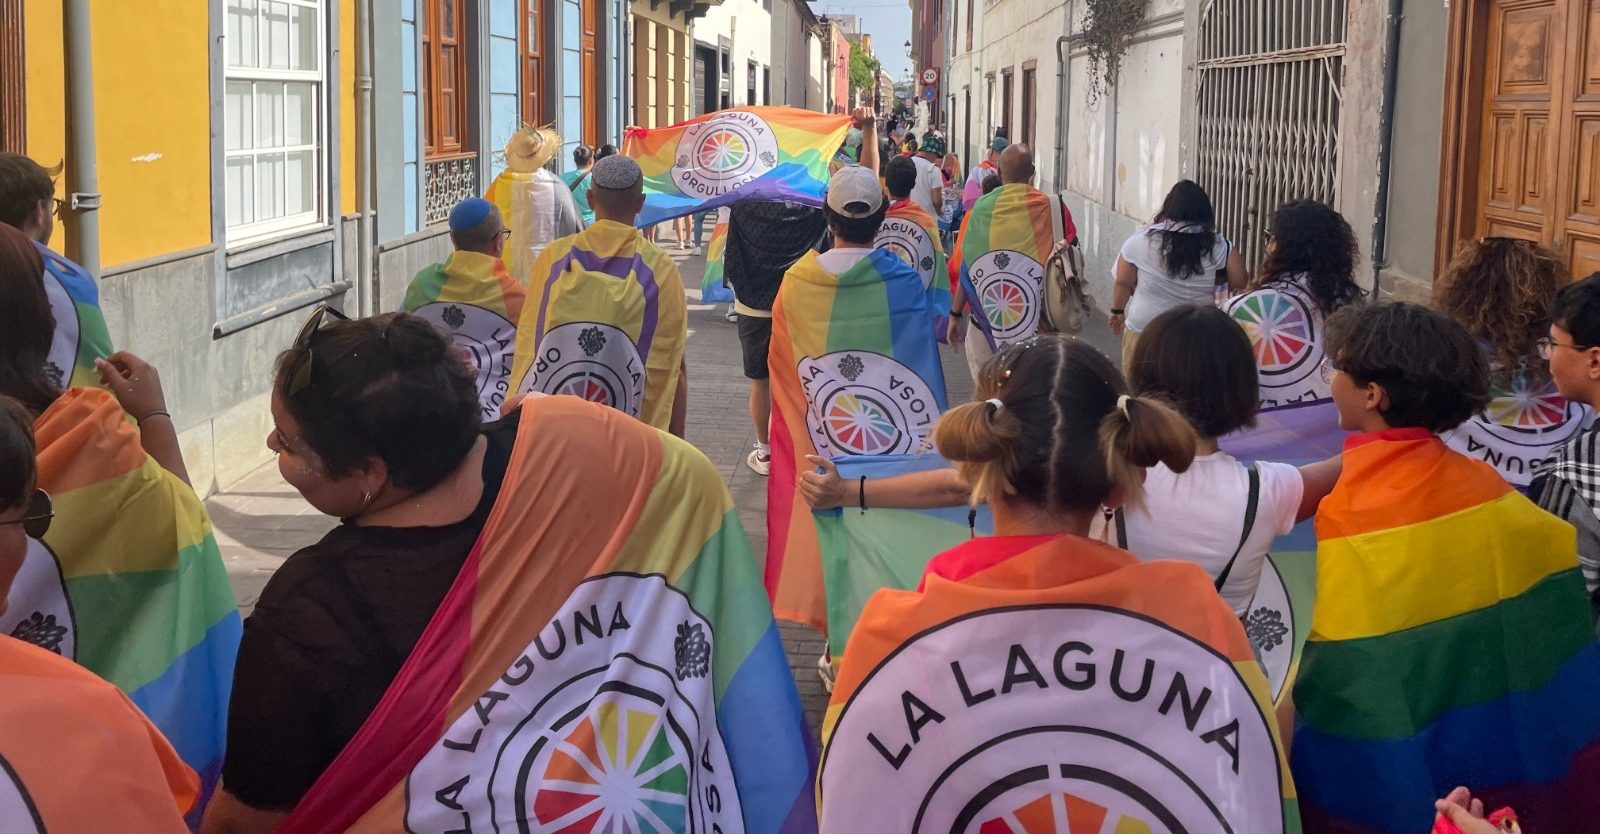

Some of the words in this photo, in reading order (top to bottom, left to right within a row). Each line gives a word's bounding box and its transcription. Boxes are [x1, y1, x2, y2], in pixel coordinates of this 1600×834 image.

[925, 72, 935, 80] 20
[879, 222, 923, 244] AGUNA
[1028, 267, 1043, 286] LA
[491, 328, 510, 351] LA
[482, 353, 515, 418] LAGUN
[1466, 434, 1543, 475] GUNA
[442, 601, 631, 753] LAGUNA
[866, 690, 946, 771] LA
[949, 640, 1240, 775] LAGUNA
